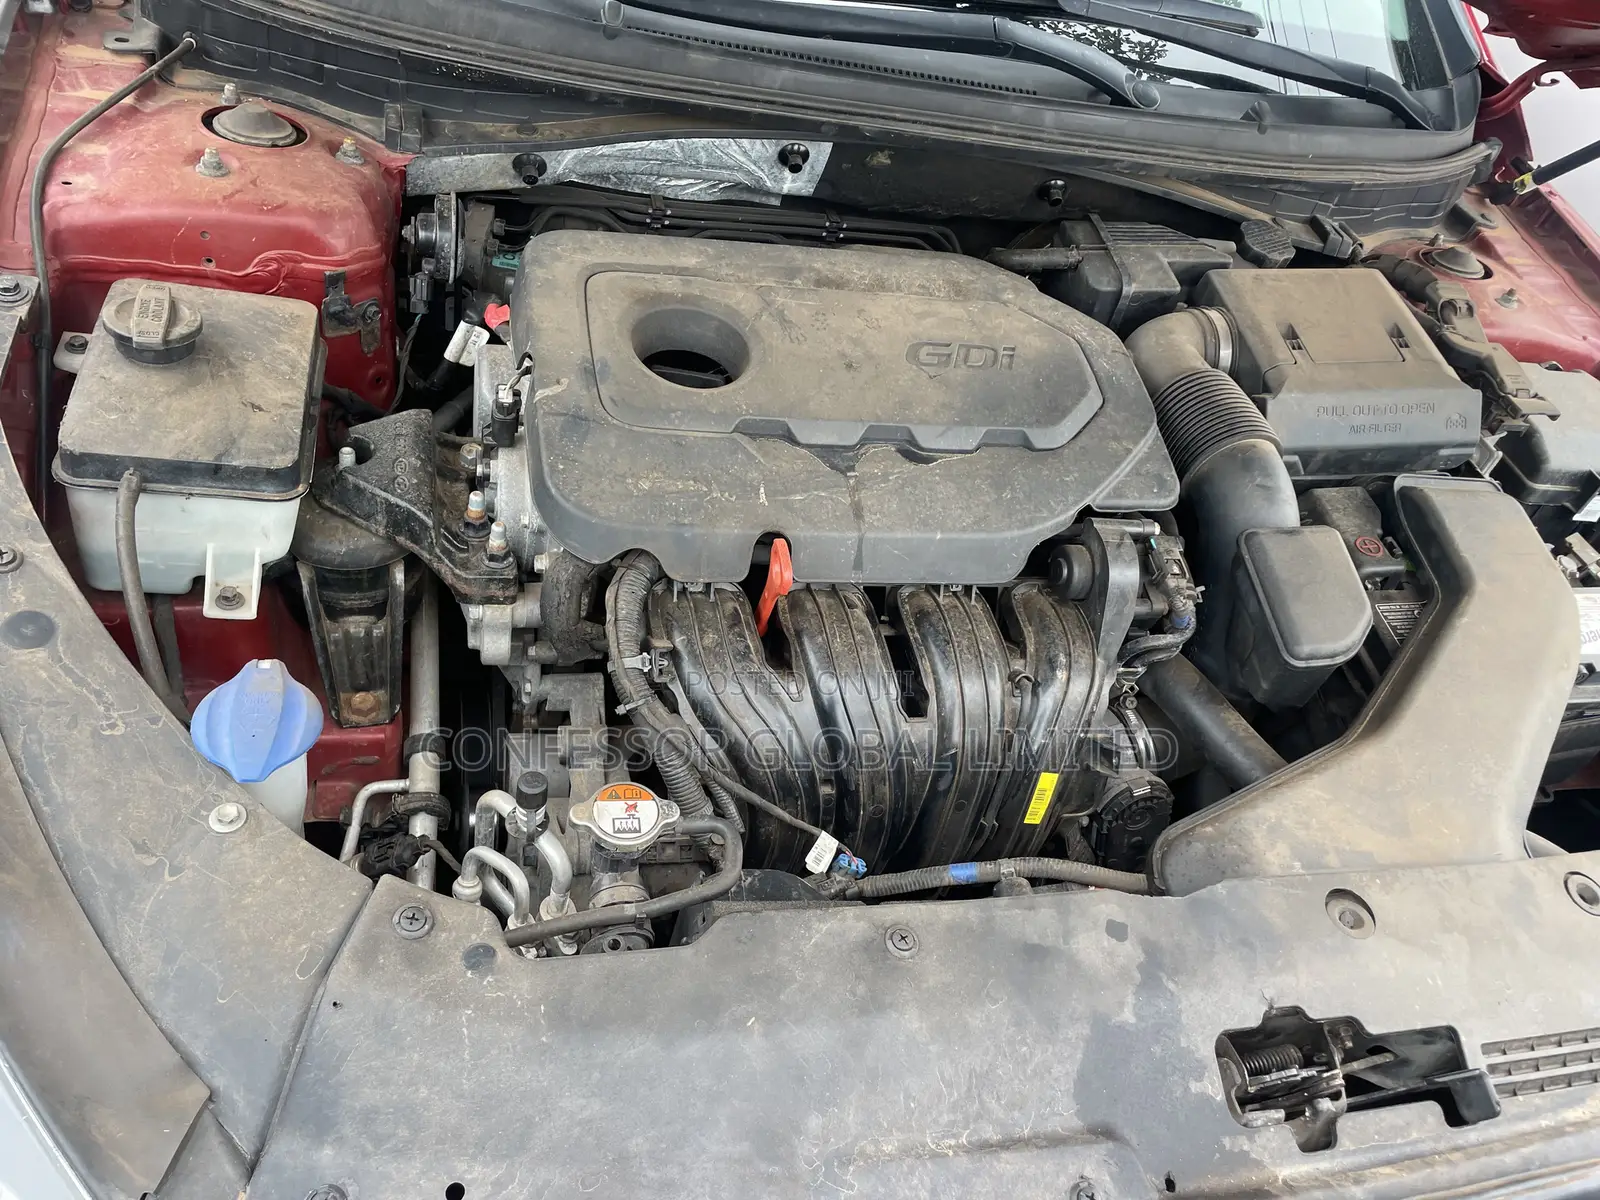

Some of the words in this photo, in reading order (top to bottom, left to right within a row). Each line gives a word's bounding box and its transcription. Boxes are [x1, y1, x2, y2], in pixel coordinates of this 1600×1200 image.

[1316, 404, 1349, 417] PULL
[1382, 403, 1398, 415] TO
[1401, 402, 1435, 415] OPEN
[1349, 424, 1366, 435] AIR
[1367, 422, 1402, 434] FILTER
